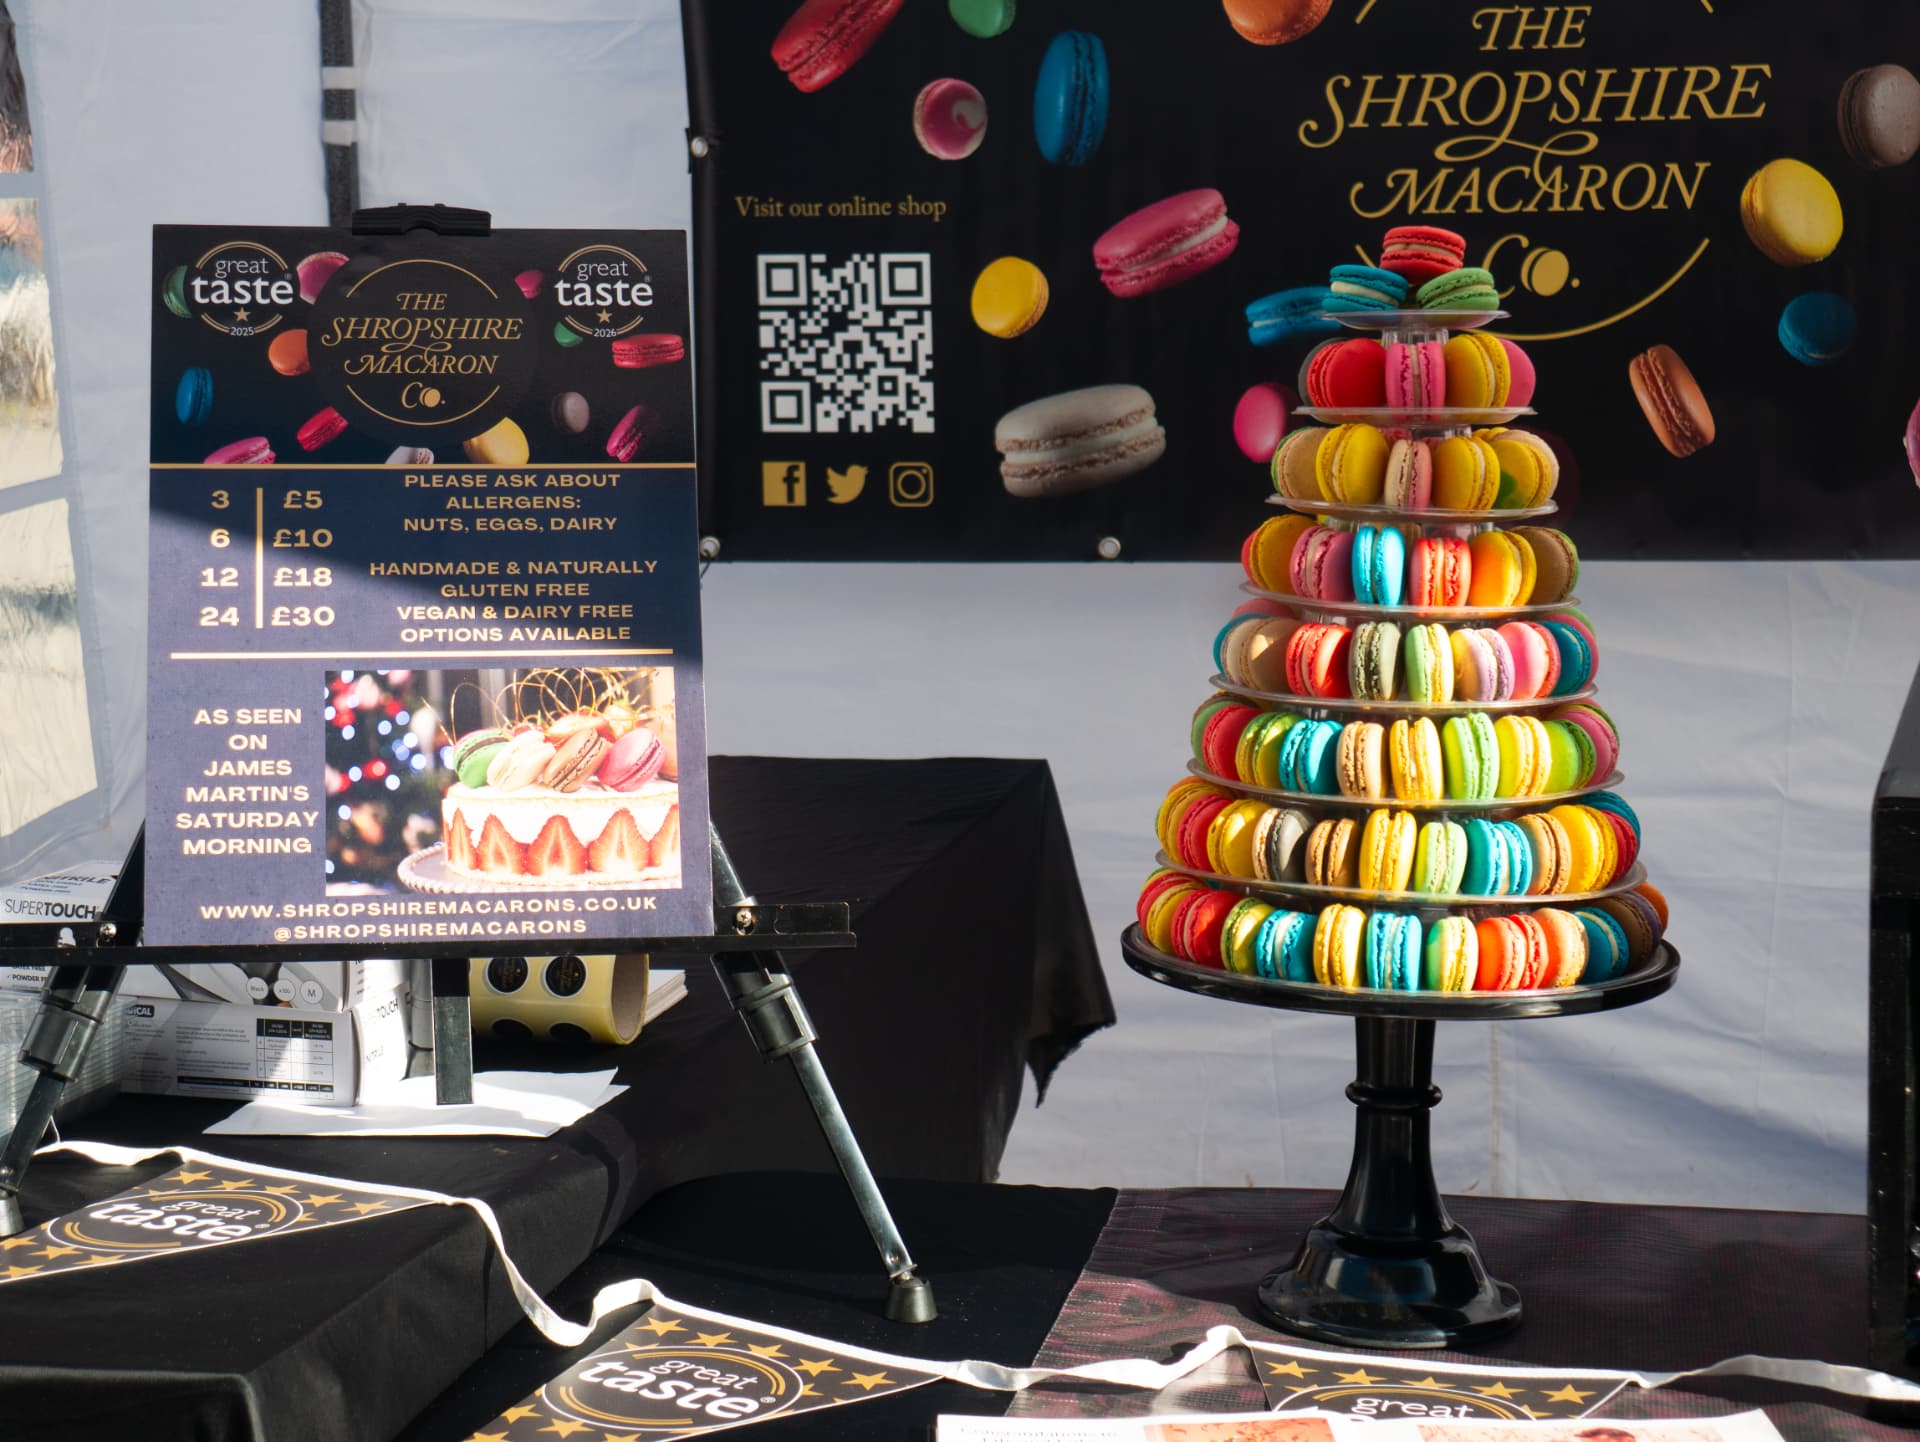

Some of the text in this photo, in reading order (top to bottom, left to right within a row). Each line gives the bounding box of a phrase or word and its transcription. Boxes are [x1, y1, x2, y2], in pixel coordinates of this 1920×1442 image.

[1471, 4, 1592, 51] THE
[1298, 64, 1772, 150] SHROPSHIRE
[1350, 161, 1711, 219] MACARON
[735, 194, 947, 222] Visit our online shop
[214, 256, 269, 277] great
[576, 259, 631, 280] great
[396, 292, 448, 312] THE
[229, 326, 255, 337] 2025
[321, 316, 523, 348] SHROPSHIRE
[592, 328, 617, 338] 2026
[343, 354, 499, 376] MACARON
[404, 473, 621, 488] PLEASE ASK ABOUT
[210, 490, 324, 510] 3 £5
[445, 496, 582, 511] ALLERGENS:
[403, 516, 618, 534] NUTS, EGGS, DAIRY
[209, 528, 334, 549] 6 £10
[201, 567, 333, 588] 12 £18
[369, 560, 658, 577] HANDMADE & NATURALLY
[440, 583, 591, 598] GLUTEN FREE
[199, 606, 336, 628] 24 £30
[397, 604, 634, 621] VEGAN & DAIRY FREE
[400, 626, 632, 643] OPTIONS AVAILABLE
[193, 707, 302, 726] AS SEEN
[227, 733, 269, 751] ON
[203, 759, 293, 777] JAMES
[186, 785, 310, 803] MARTIN'S
[175, 811, 320, 830] SATURDAY
[182, 837, 313, 856] MORNING
[5, 898, 97, 919] SUPERTOUCH
[200, 896, 657, 920] WWW.SHROPSHIREMACARONS.CO.UK
[273, 919, 588, 942] @SHROPSHIREMACARONS
[308, 989, 316, 998] M
[162, 1199, 262, 1221] great
[649, 1358, 759, 1391] great
[1351, 1397, 1474, 1418] great
